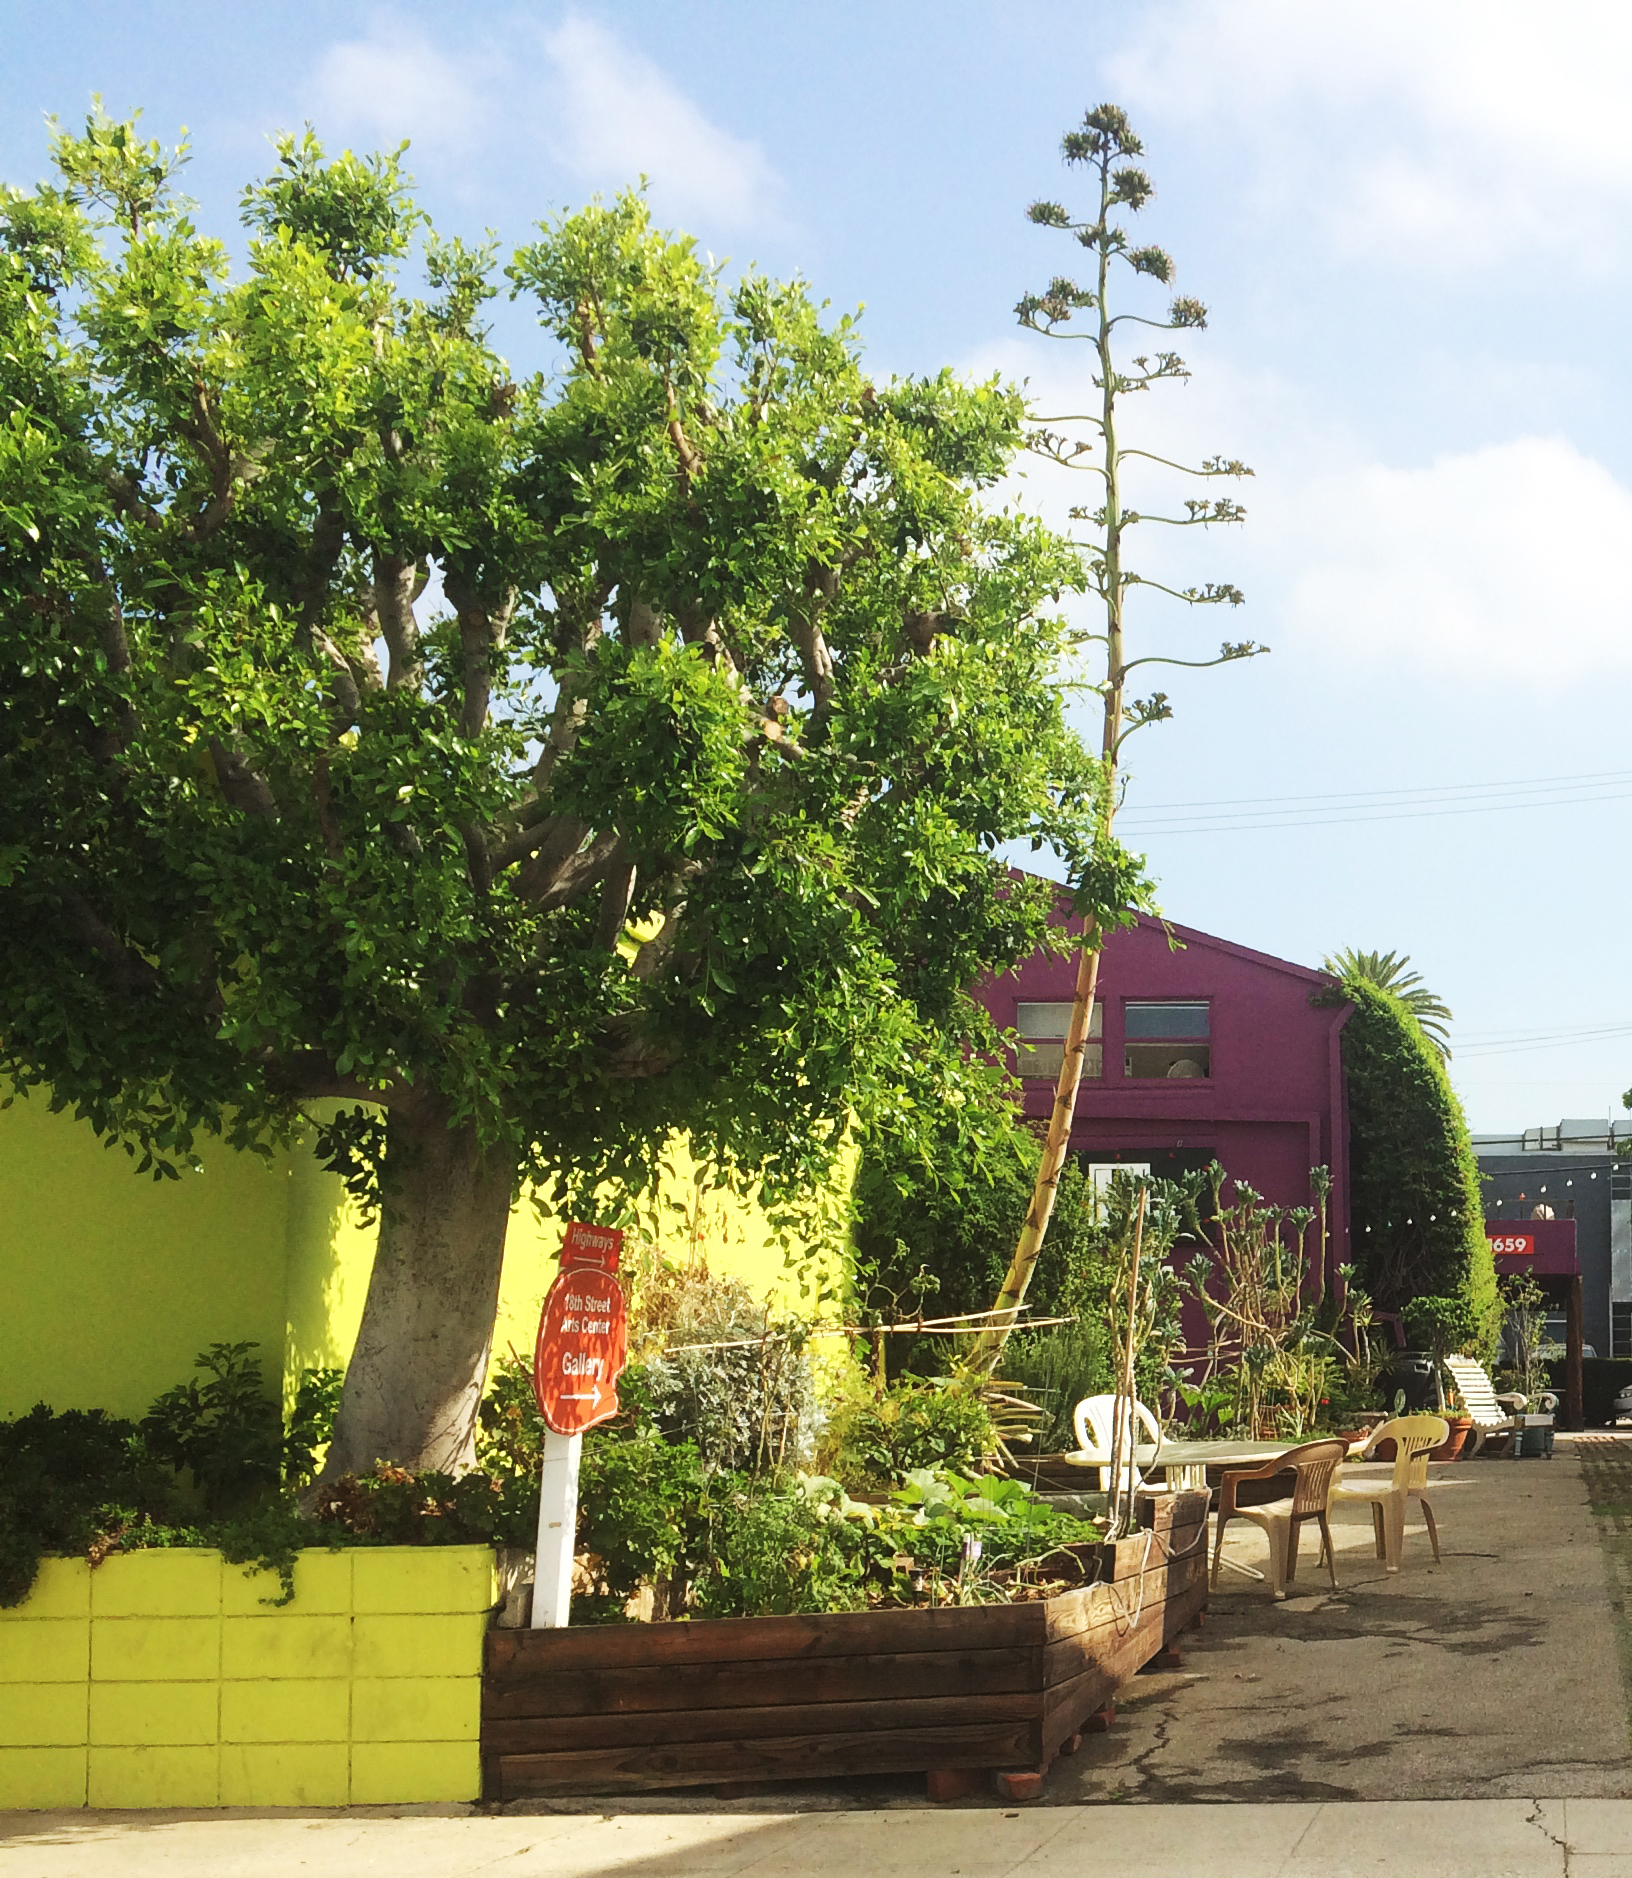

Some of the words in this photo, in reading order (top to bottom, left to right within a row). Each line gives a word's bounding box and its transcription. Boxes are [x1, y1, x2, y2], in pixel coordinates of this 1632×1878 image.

[571, 1227, 614, 1254] Highways
[1487, 1237, 1527, 1252] 1659
[564, 1293, 583, 1312] 18th
[584, 1294, 611, 1314] Street
[560, 1315, 580, 1334] Arts
[581, 1316, 611, 1335] Center
[562, 1351, 605, 1382] Gallery
